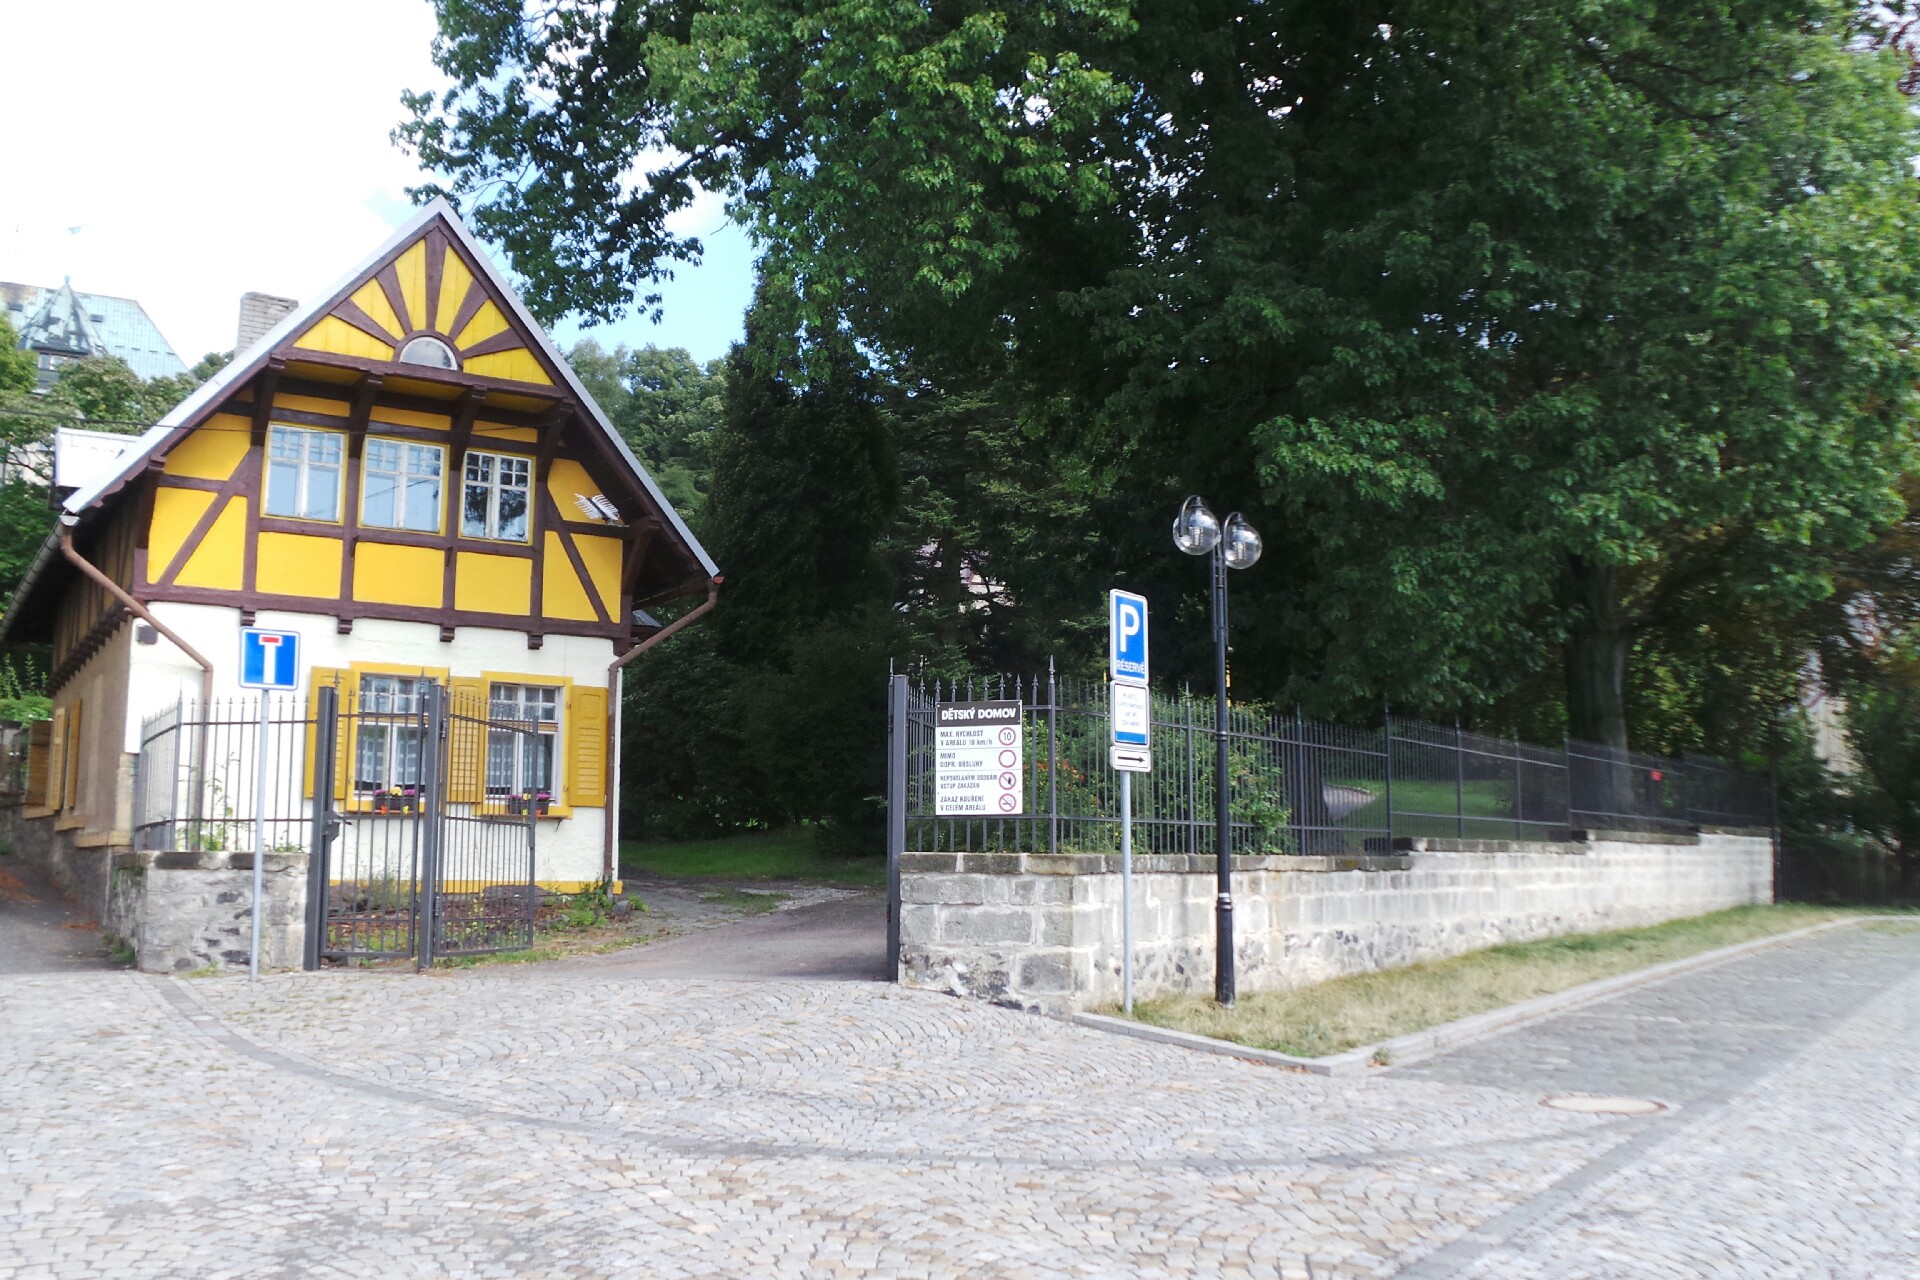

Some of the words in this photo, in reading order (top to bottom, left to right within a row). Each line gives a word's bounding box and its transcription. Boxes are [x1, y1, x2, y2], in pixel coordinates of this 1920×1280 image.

[1120, 604, 1140, 653] P
[1117, 658, 1145, 674] RÉSERVÉ
[941, 707, 975, 720] DĚTSKÝ
[977, 707, 1017, 719] DOMOV
[955, 730, 984, 738] RYCHLOST
[1003, 732, 1012, 741] 10
[945, 738, 967, 746] AREÁLU
[976, 738, 993, 746] km/h
[940, 795, 958, 803] ZÁKAZ
[959, 794, 984, 803] KOUŘENÍ
[945, 803, 964, 811] CELÉM
[964, 803, 986, 811] AREÁLU
